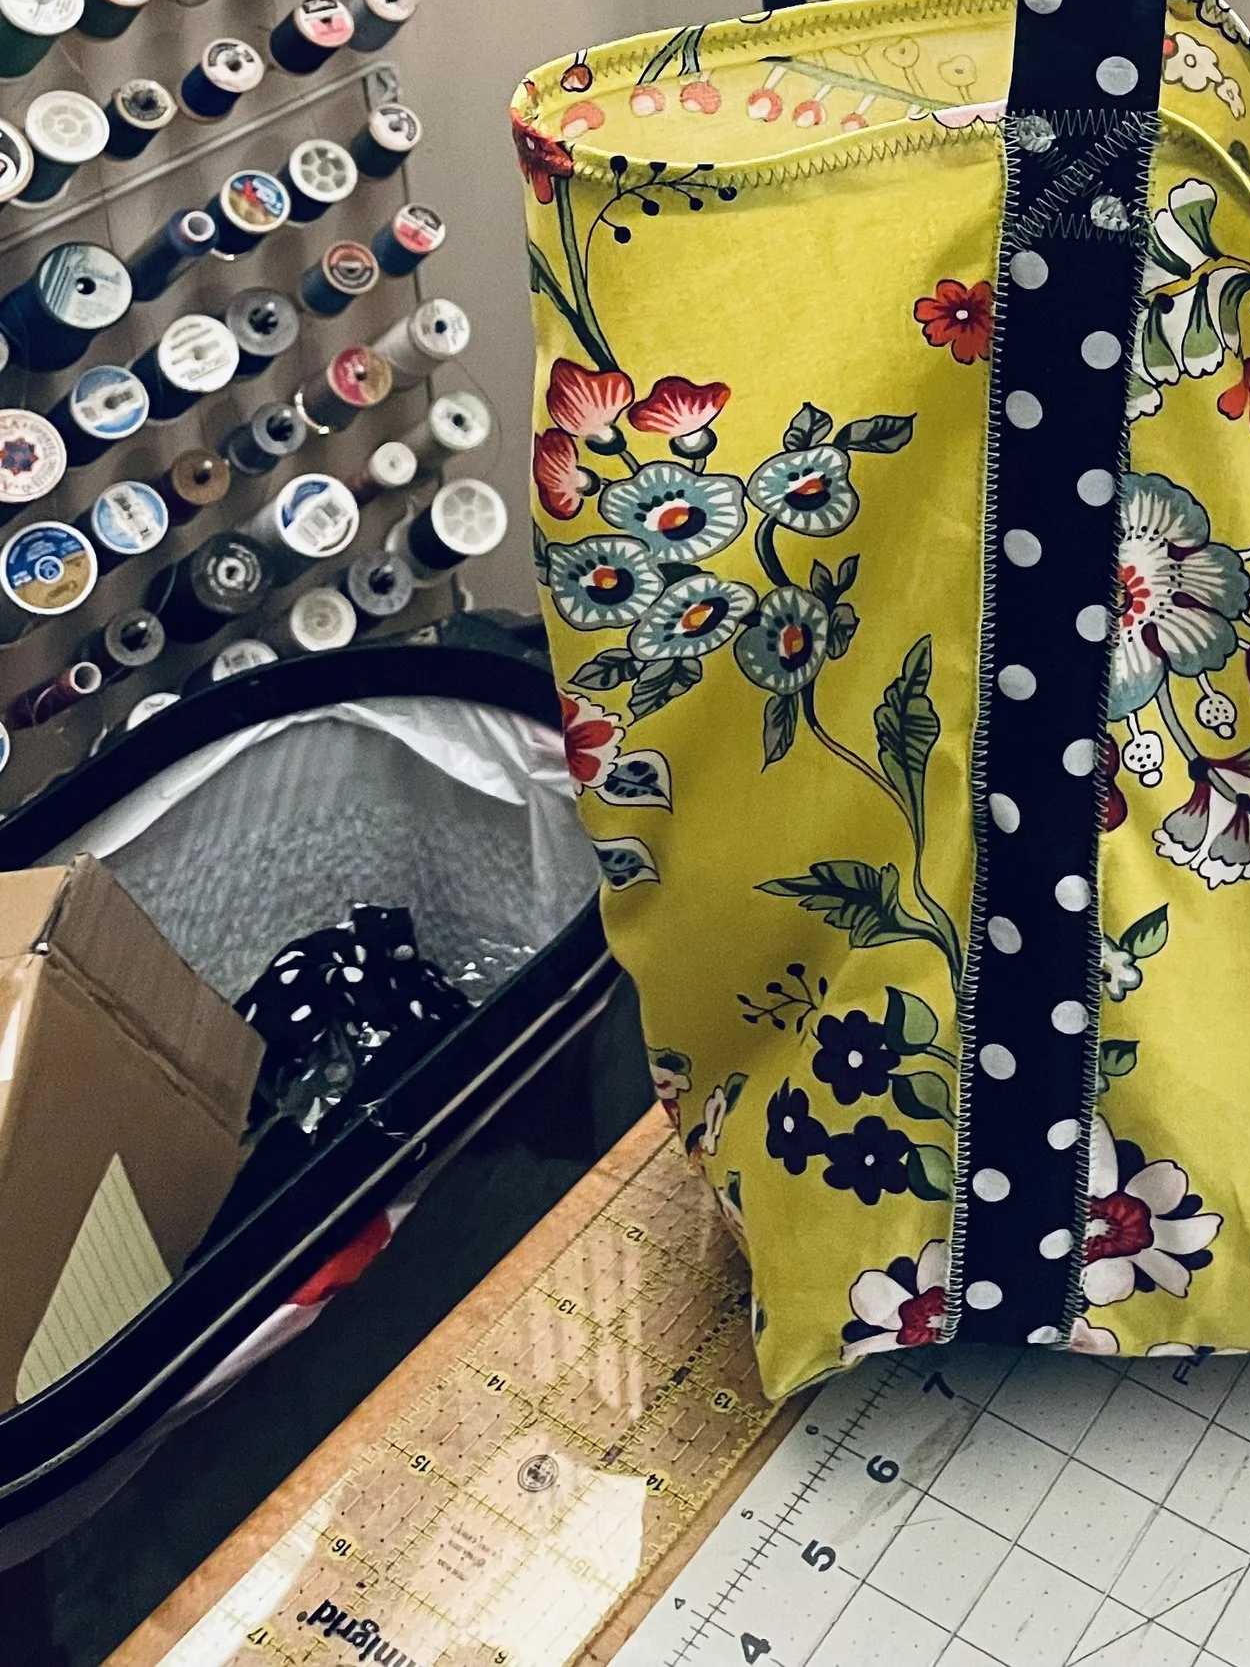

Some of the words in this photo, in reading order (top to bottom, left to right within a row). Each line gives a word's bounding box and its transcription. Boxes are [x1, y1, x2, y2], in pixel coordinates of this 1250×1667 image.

[626, 1226, 646, 1242] 12
[558, 1299, 577, 1314] 13
[487, 1374, 506, 1391] 14
[922, 1371, 955, 1400] 7
[714, 1392, 734, 1409] 13
[805, 1425, 819, 1435] 6
[410, 1455, 431, 1472] 15
[866, 1455, 899, 1484] 6
[740, 1507, 754, 1520] 5
[332, 1538, 352, 1557] 16
[801, 1539, 837, 1572] 5
[674, 1597, 686, 1610] 4
[246, 1627, 268, 1645] 17
[306, 1599, 416, 1667] nigrid
[740, 1632, 772, 1665] 4
